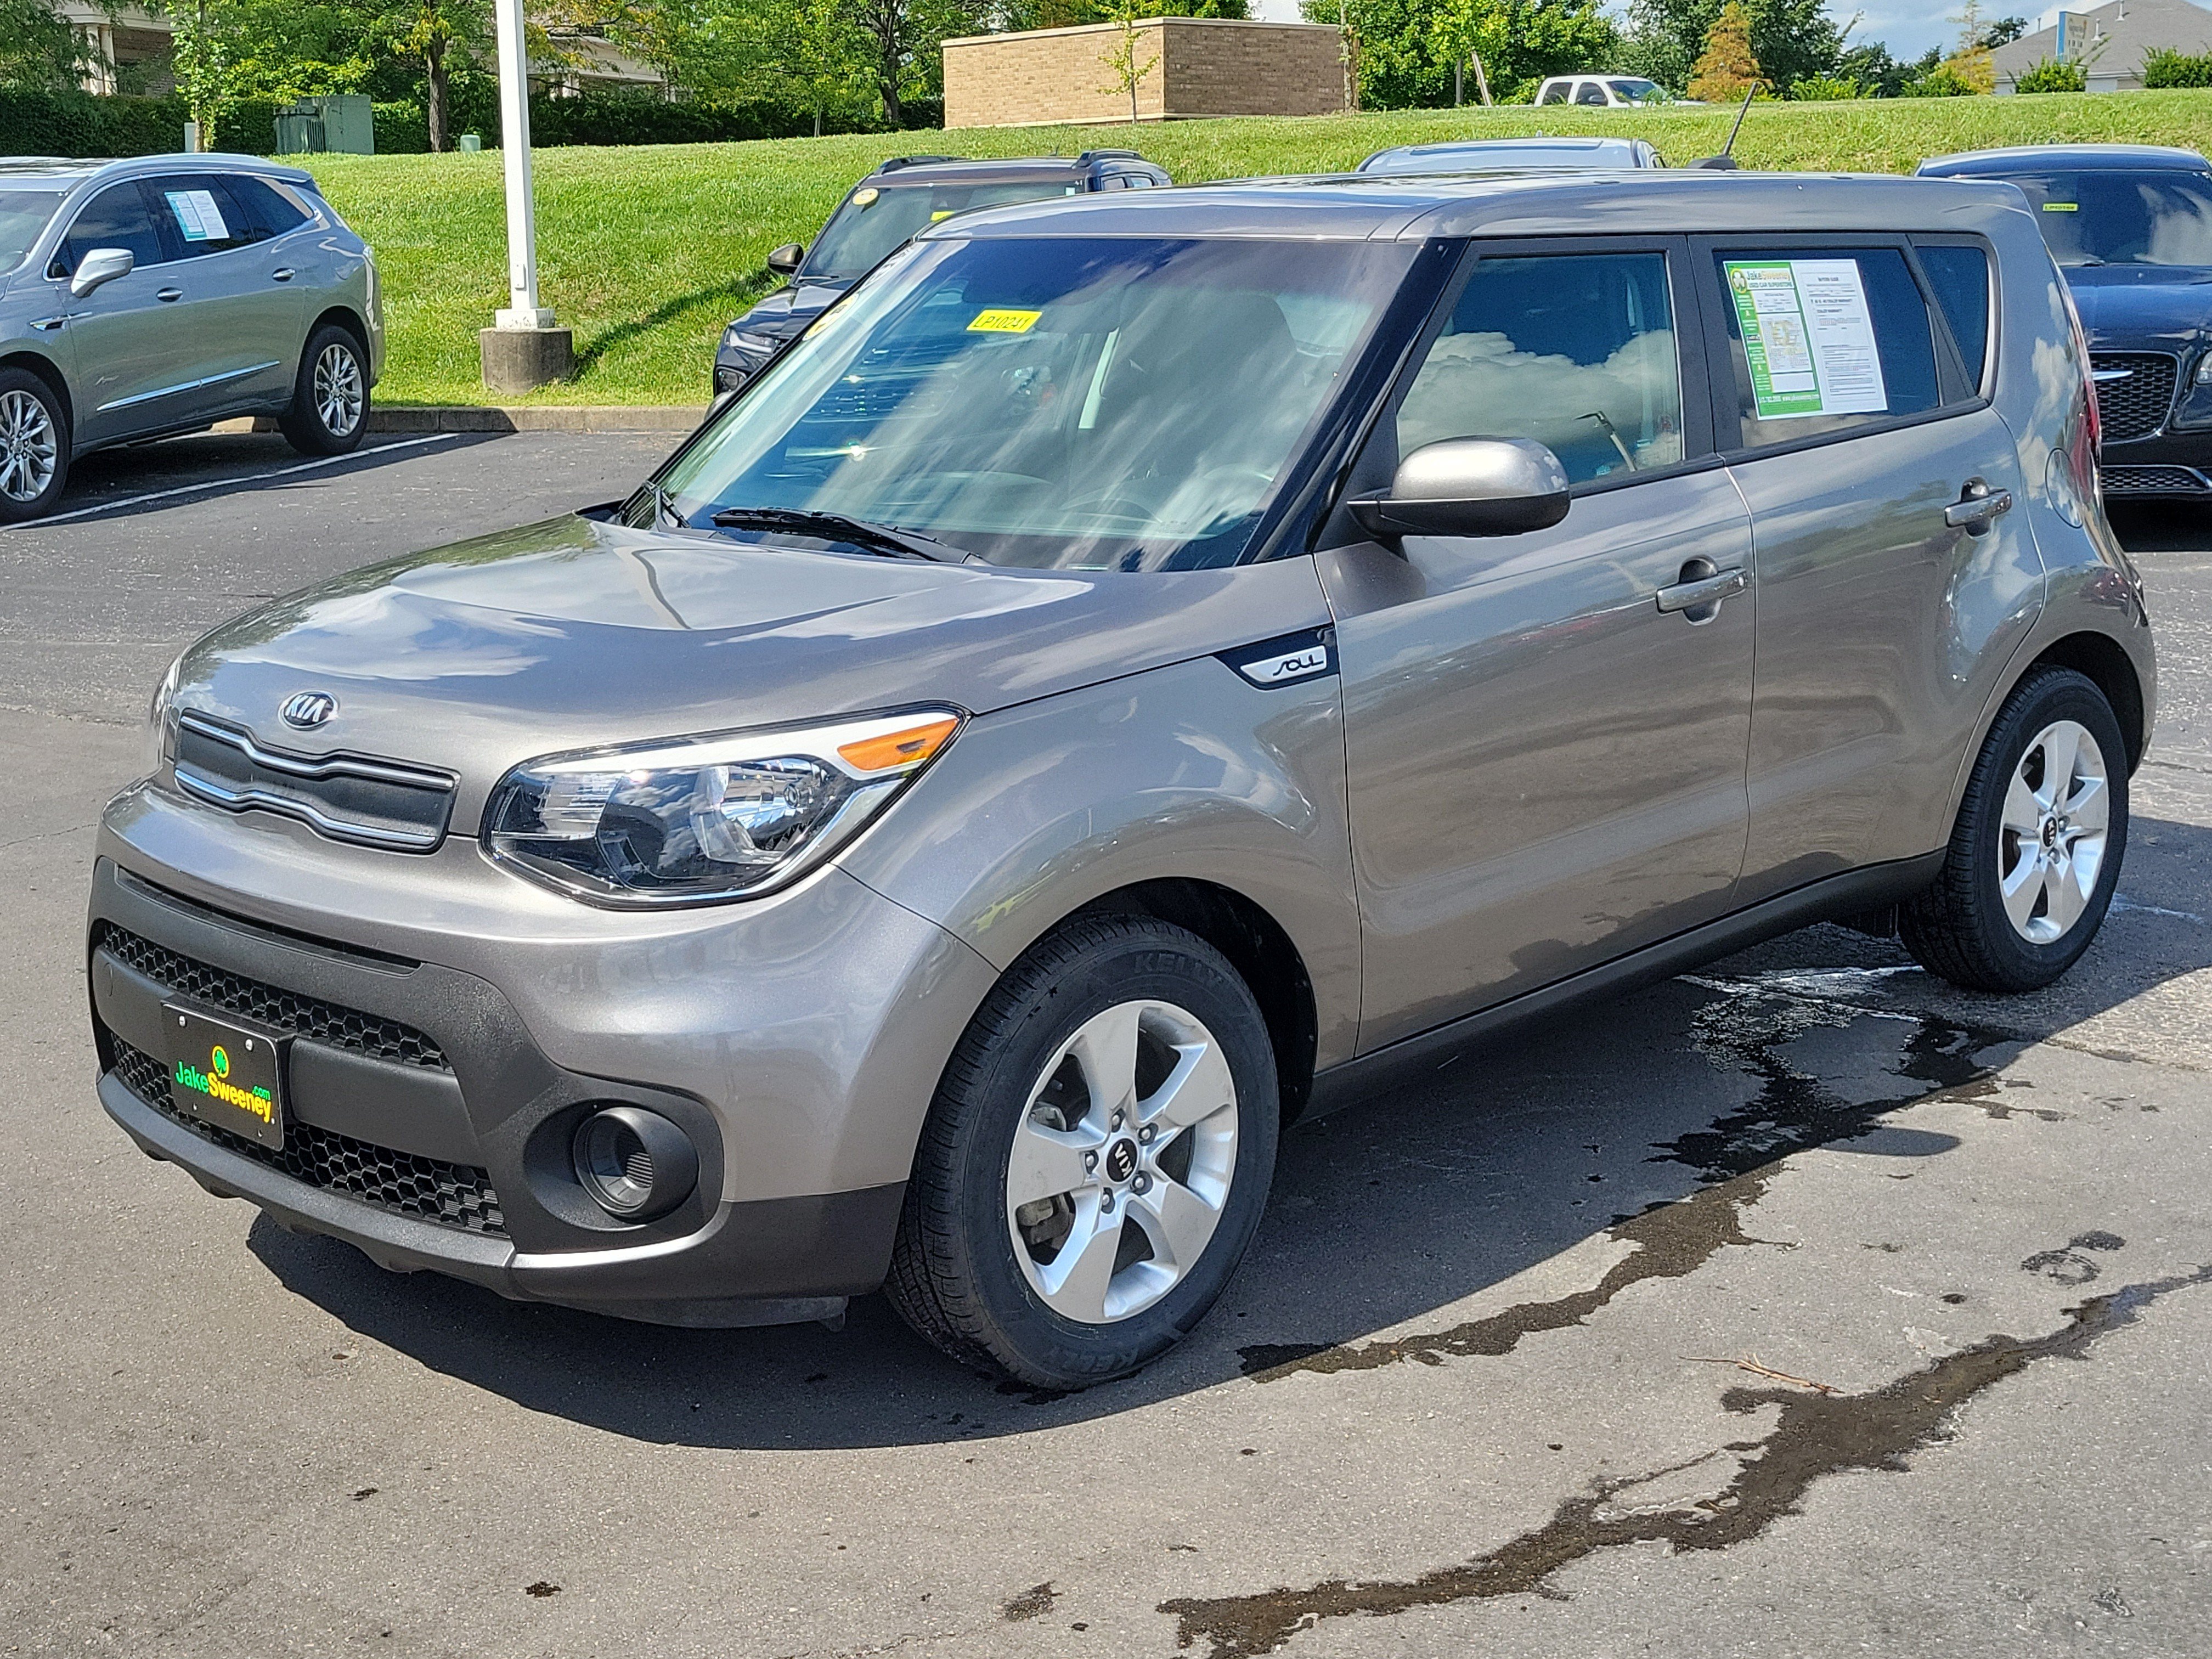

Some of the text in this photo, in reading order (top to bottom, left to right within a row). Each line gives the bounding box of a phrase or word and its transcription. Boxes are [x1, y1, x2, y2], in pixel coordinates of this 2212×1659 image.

[285, 694, 328, 723] KIA
[175, 1060, 272, 1123] JakeSweeney
[1115, 1142, 1132, 1178] KIA
